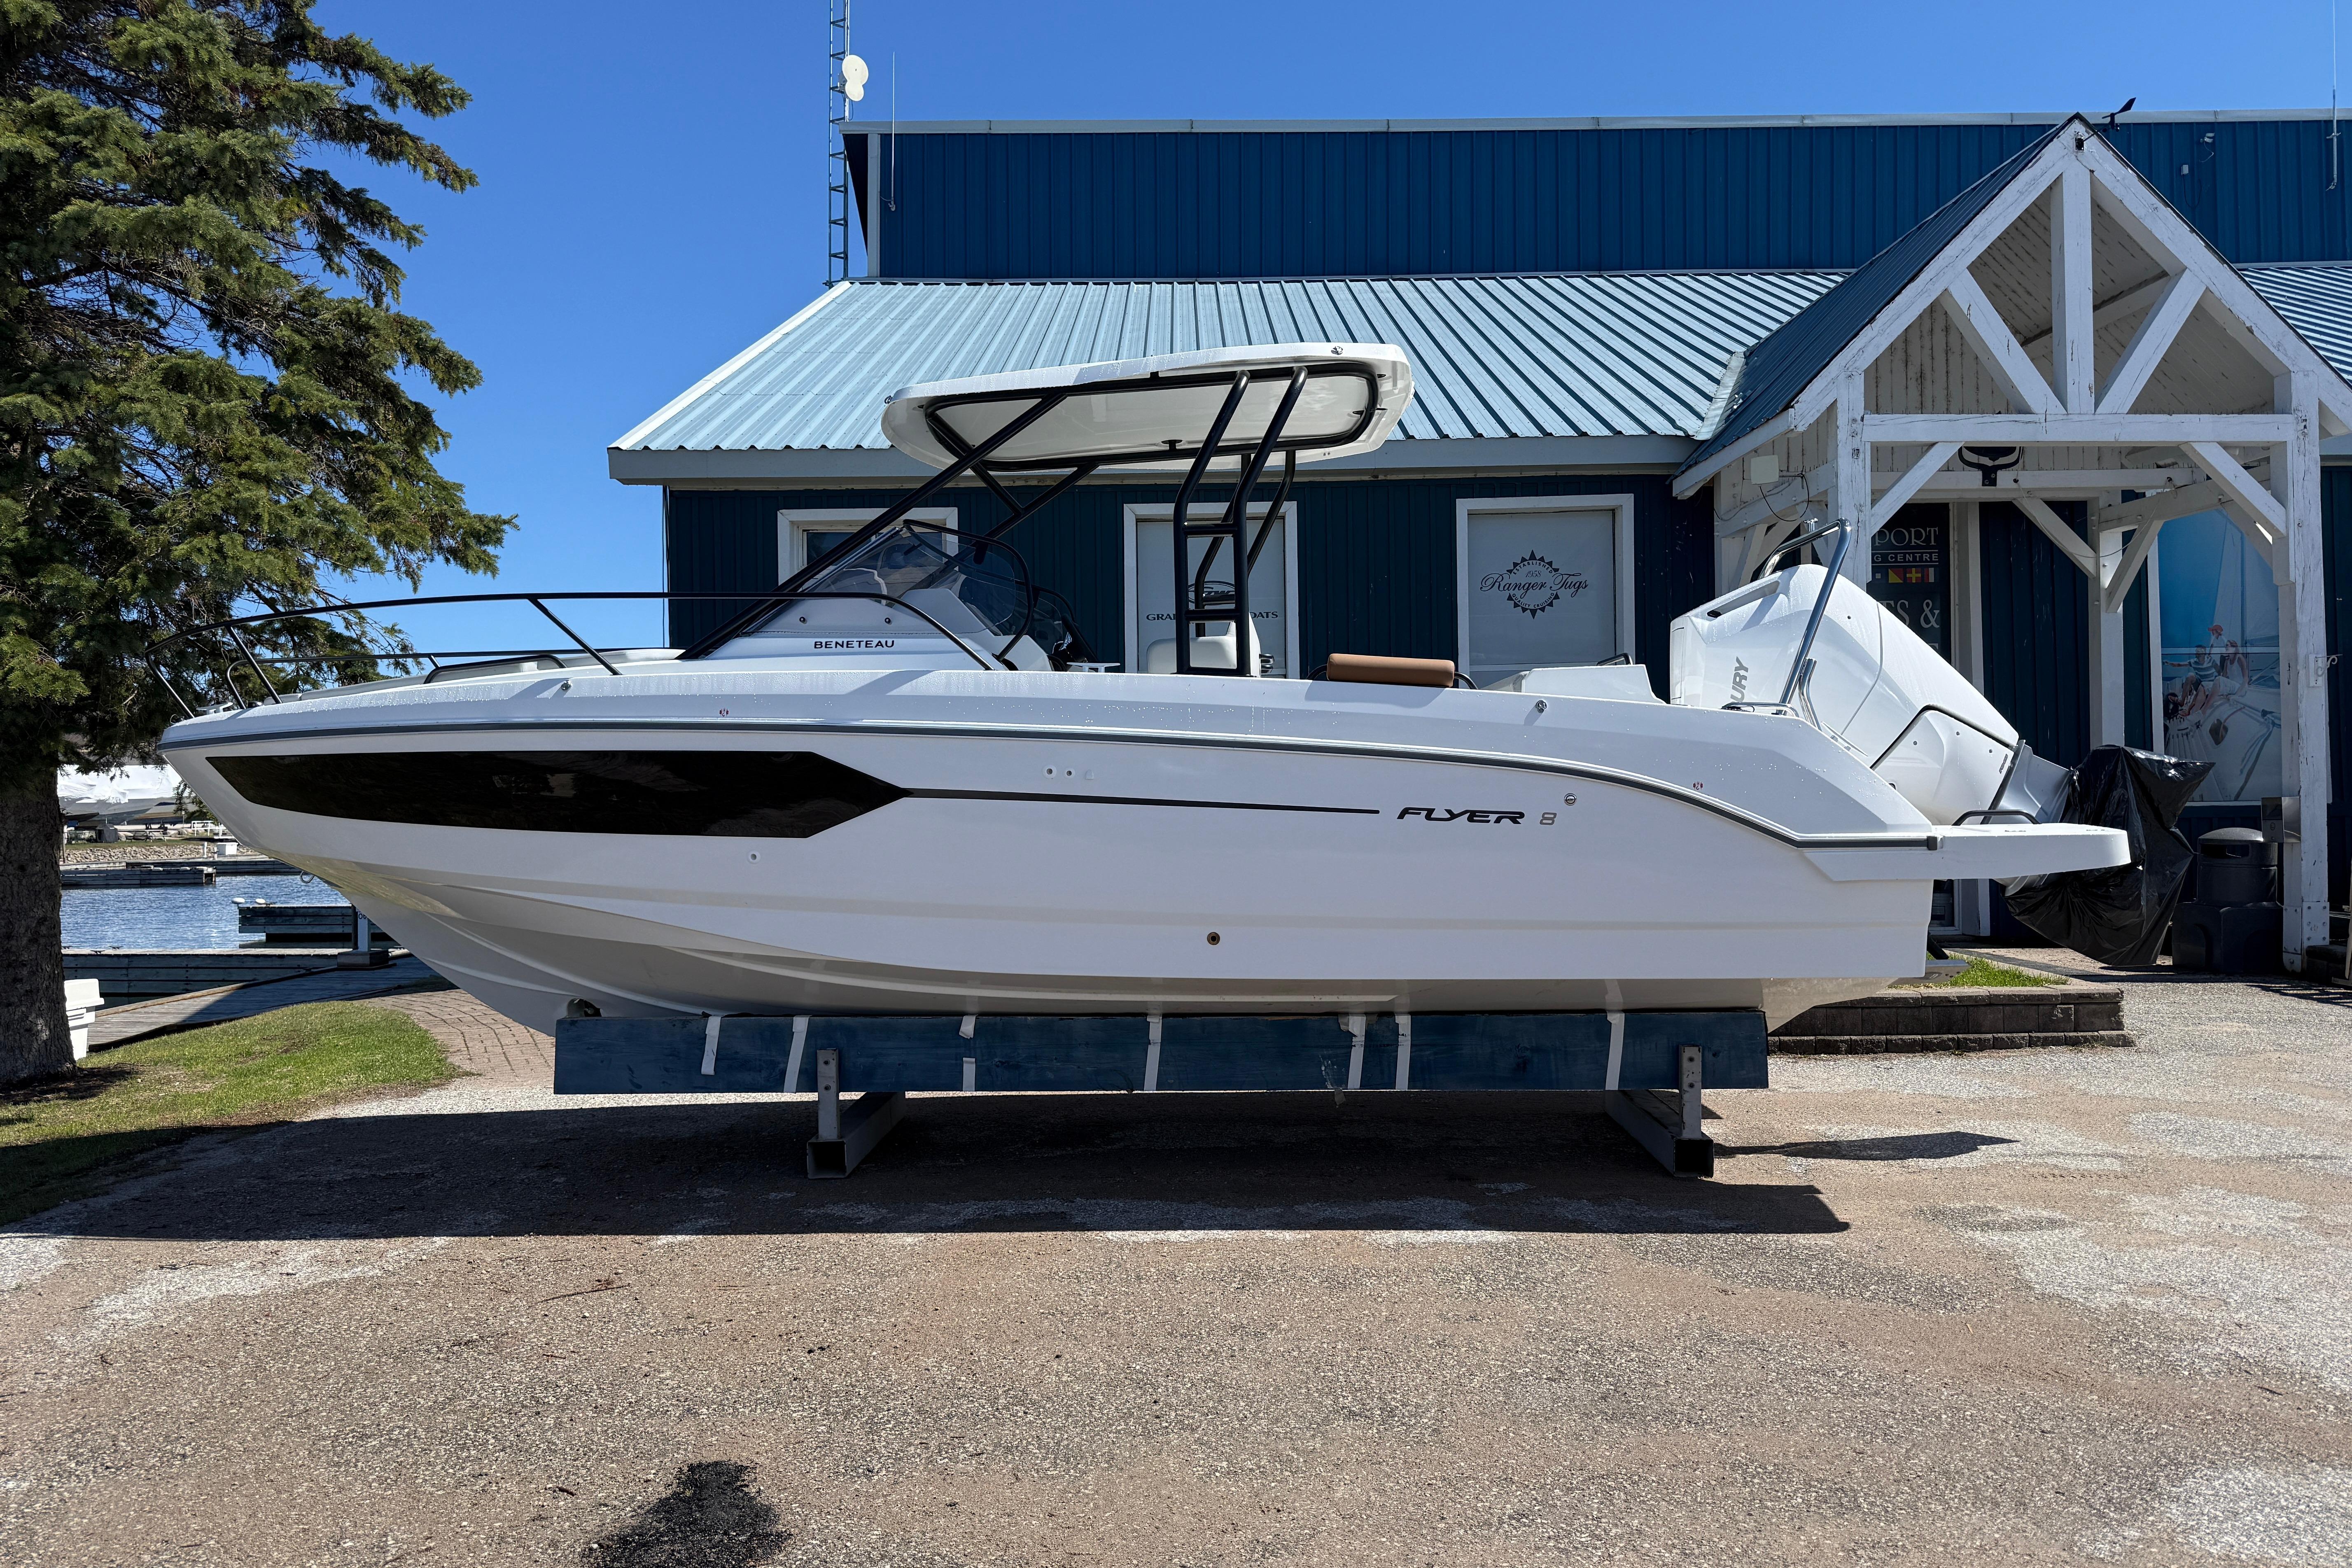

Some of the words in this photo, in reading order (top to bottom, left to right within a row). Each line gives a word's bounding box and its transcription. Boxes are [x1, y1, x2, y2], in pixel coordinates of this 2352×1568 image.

[1888, 553, 1939, 562] CENTRE
[1513, 561, 1553, 575] ESTABLISHED
[1480, 573, 1547, 599] Ranger
[1549, 573, 1588, 597] Tugs
[1512, 593, 1531, 608] QUALITY
[1533, 593, 1554, 608] CRUISING
[814, 640, 894, 649] BENETEAU
[1730, 656, 1749, 702] URY
[1397, 807, 1525, 824] FLYER
[1540, 812, 1557, 825] 8
